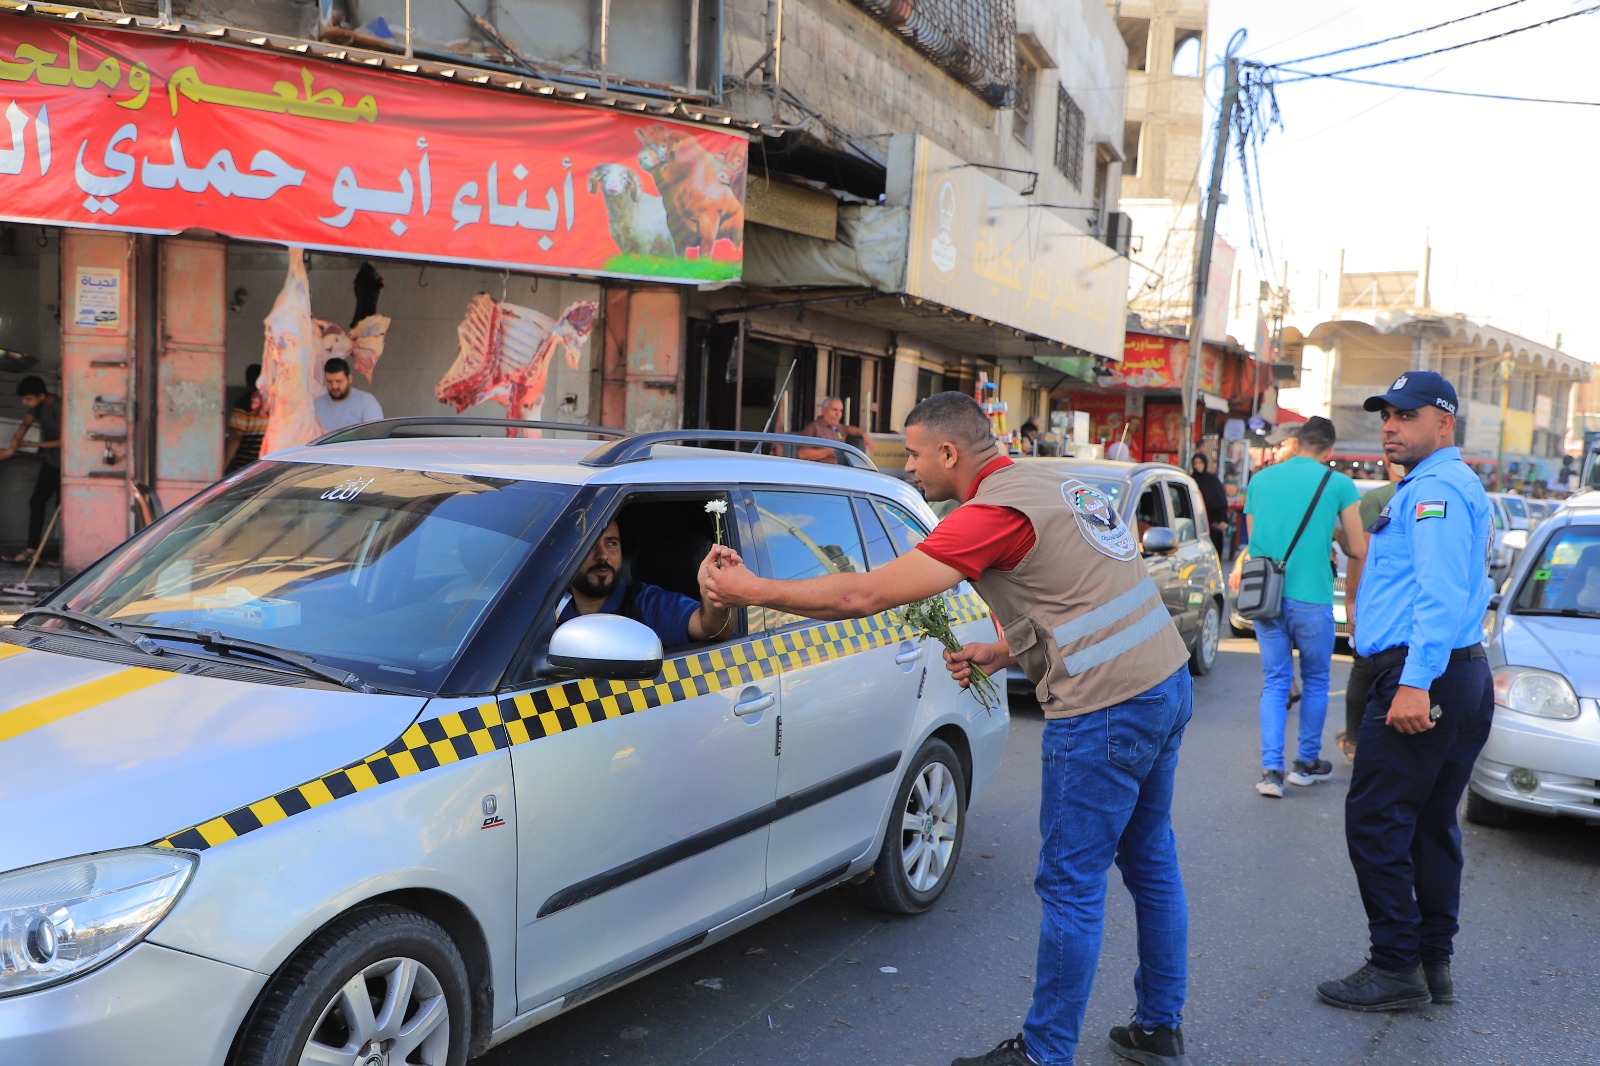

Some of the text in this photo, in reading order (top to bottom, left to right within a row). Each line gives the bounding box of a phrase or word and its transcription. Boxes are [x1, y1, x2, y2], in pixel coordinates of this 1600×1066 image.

[0, 36, 379, 124] مطعم وملح
[74, 123, 306, 216] حمدي
[318, 136, 432, 236] أبو
[451, 157, 575, 252] أبناء
